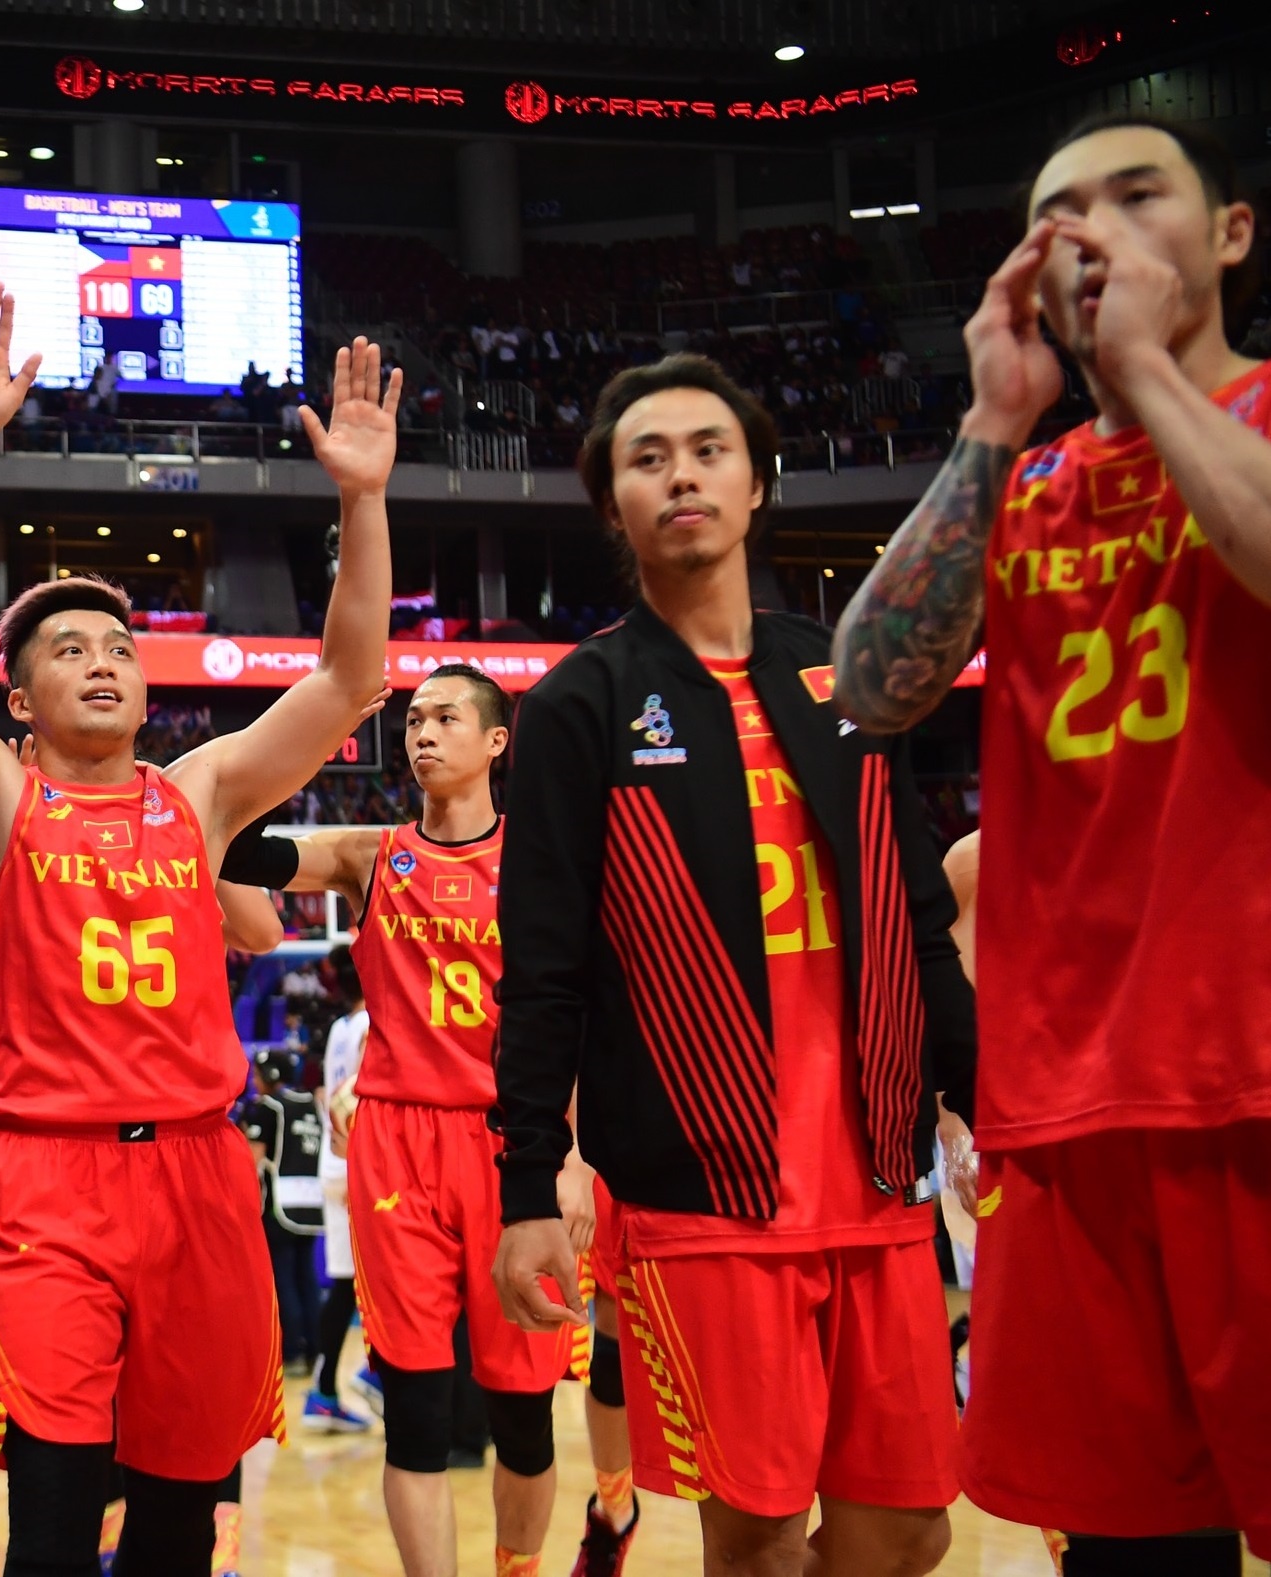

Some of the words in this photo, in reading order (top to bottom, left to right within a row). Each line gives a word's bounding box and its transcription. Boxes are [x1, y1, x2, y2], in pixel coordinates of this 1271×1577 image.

[24, 194, 100, 214] BASKETBALL
[147, 202, 182, 218] TEAM
[83, 280, 128, 314] 110
[140, 283, 174, 316] 69
[995, 511, 1210, 600] VIETNA
[247, 652, 320, 669] MOR
[1045, 602, 1189, 763] 23
[28, 851, 199, 894] VIETNAM
[755, 841, 836, 955] 21
[378, 913, 502, 946] VIETNA
[78, 915, 177, 1008] 65
[426, 956, 487, 1028] 19
